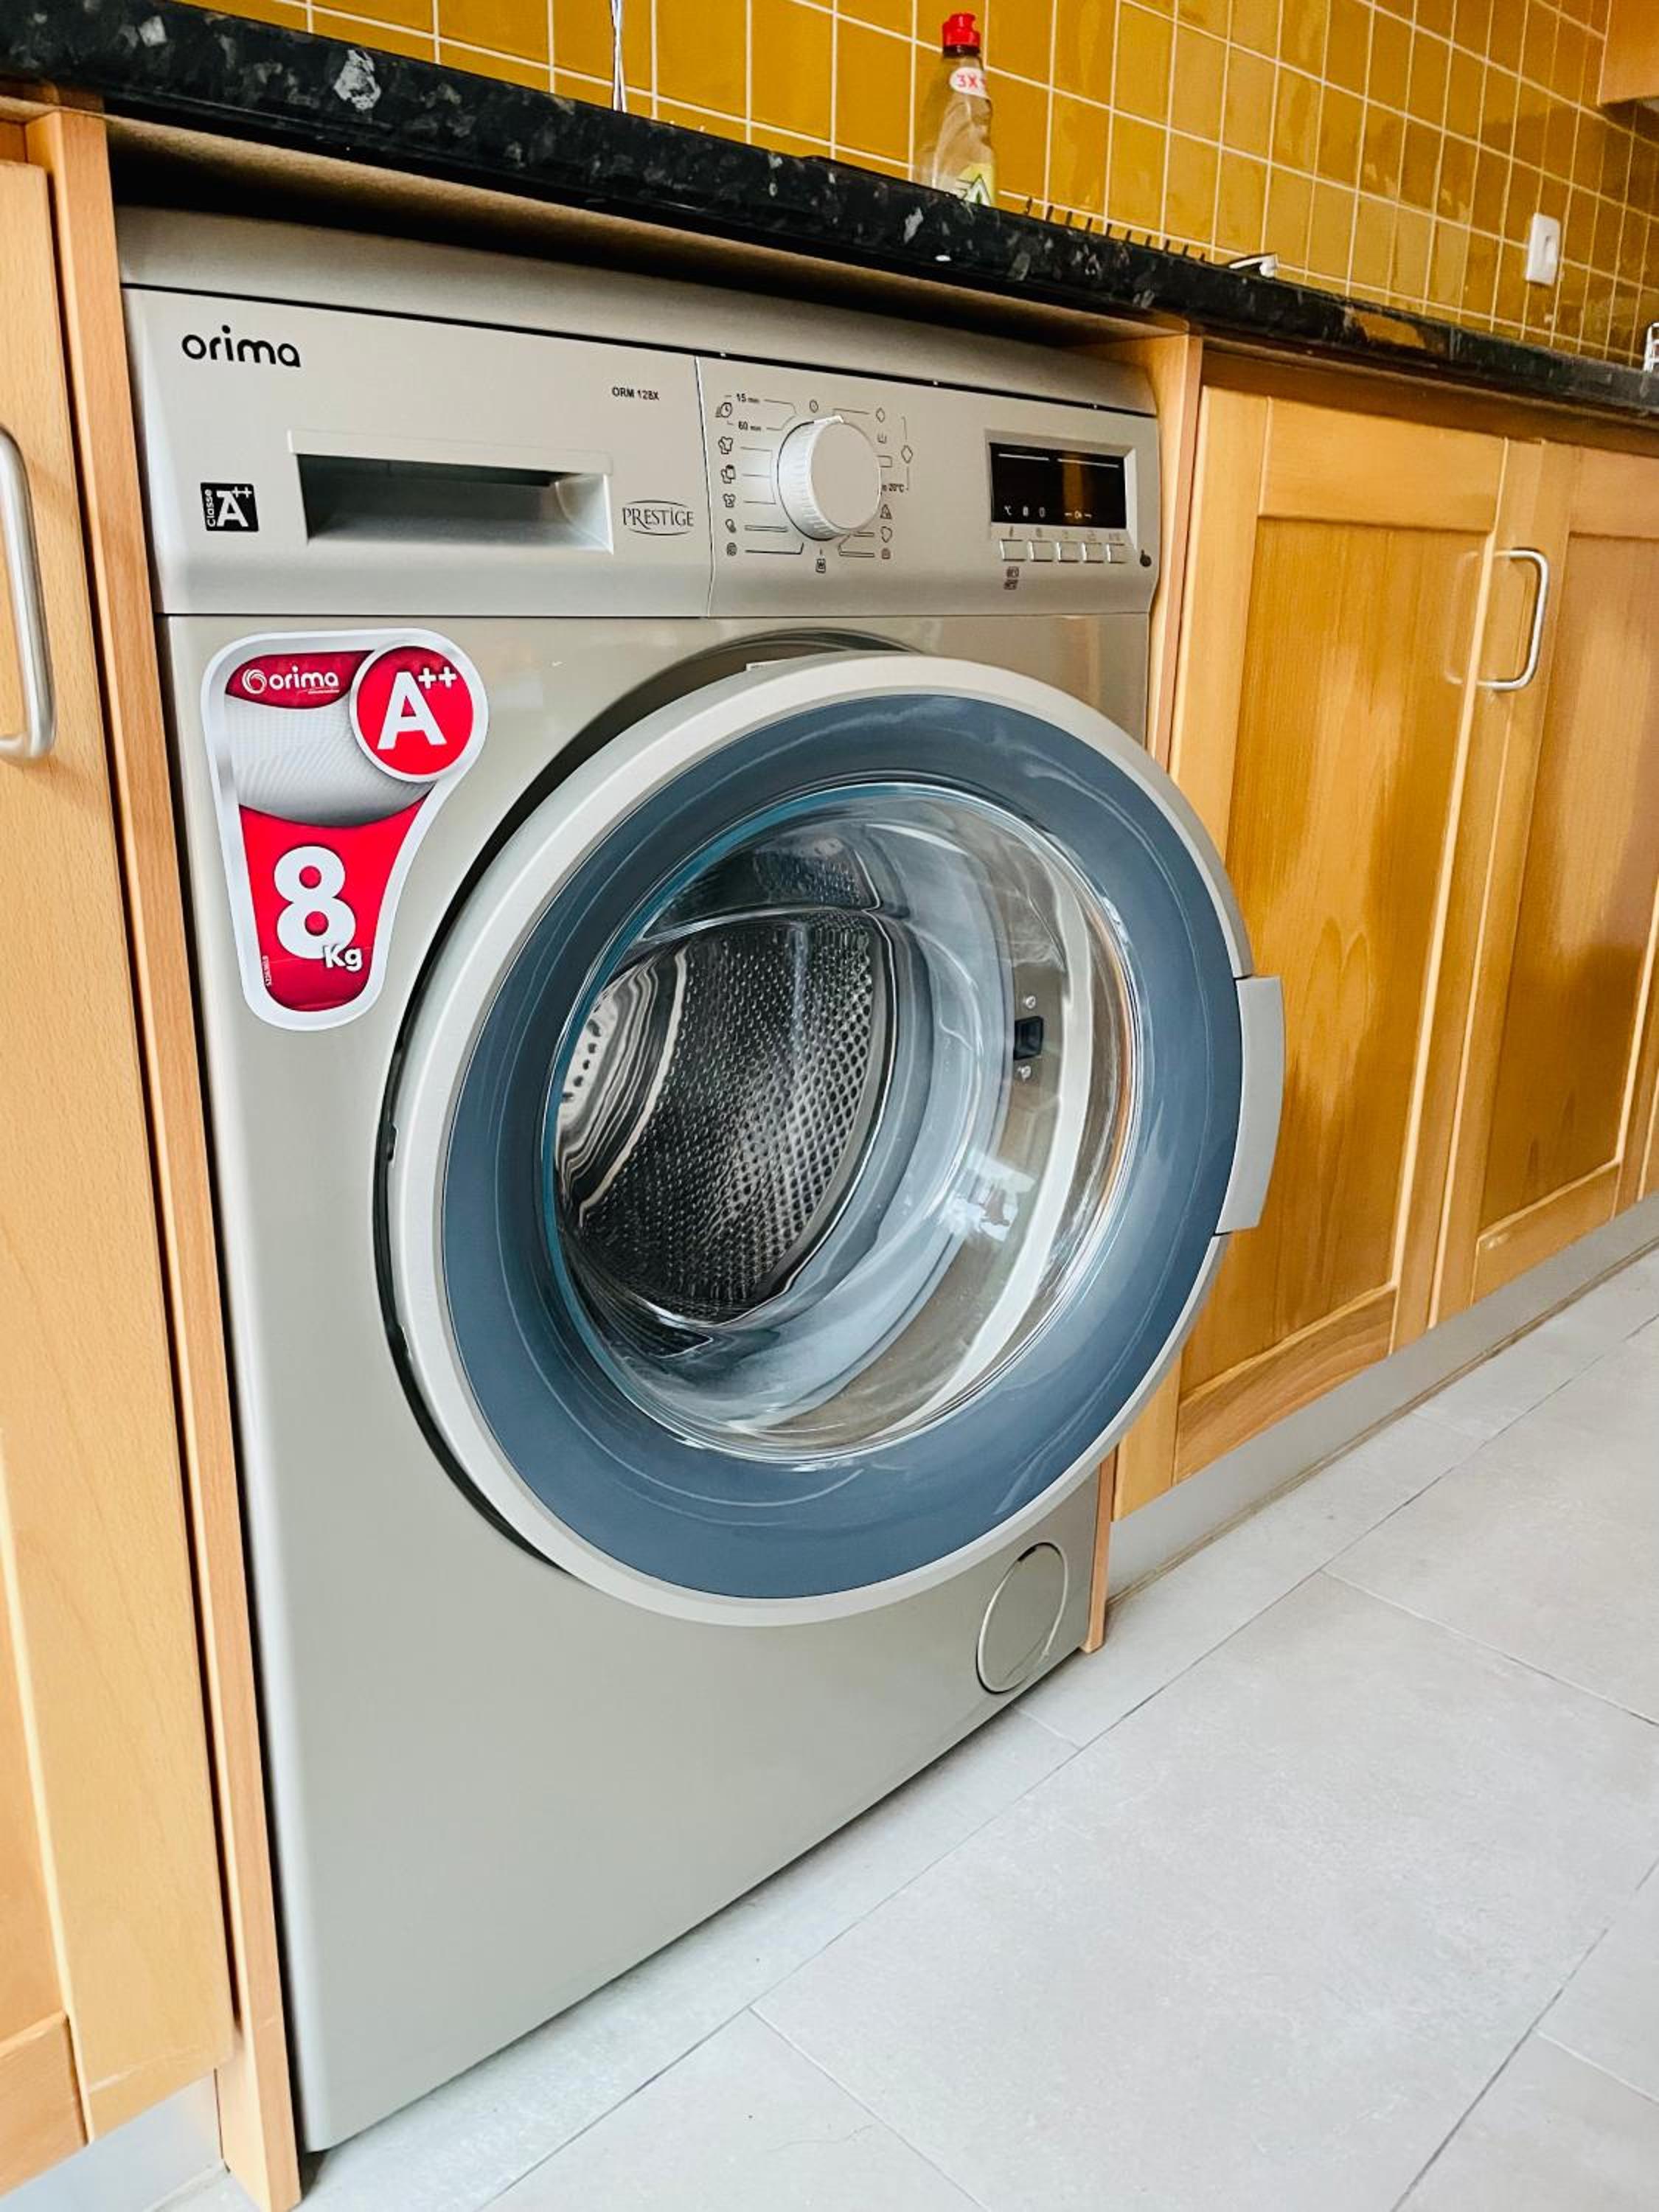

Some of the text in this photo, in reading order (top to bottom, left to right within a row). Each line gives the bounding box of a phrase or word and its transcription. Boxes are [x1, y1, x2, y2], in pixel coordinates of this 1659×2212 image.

[181, 324, 301, 367] orima
[612, 387, 659, 400] ORM 128X
[737, 393, 746, 402] 15
[738, 421, 748, 431] 60
[204, 489, 216, 527] Classe
[216, 486, 252, 526] A++
[622, 507, 694, 529] PRESTIGE
[269, 665, 339, 689] orima
[377, 667, 457, 750] A++
[274, 846, 356, 959] 8
[324, 945, 363, 973] Kg
